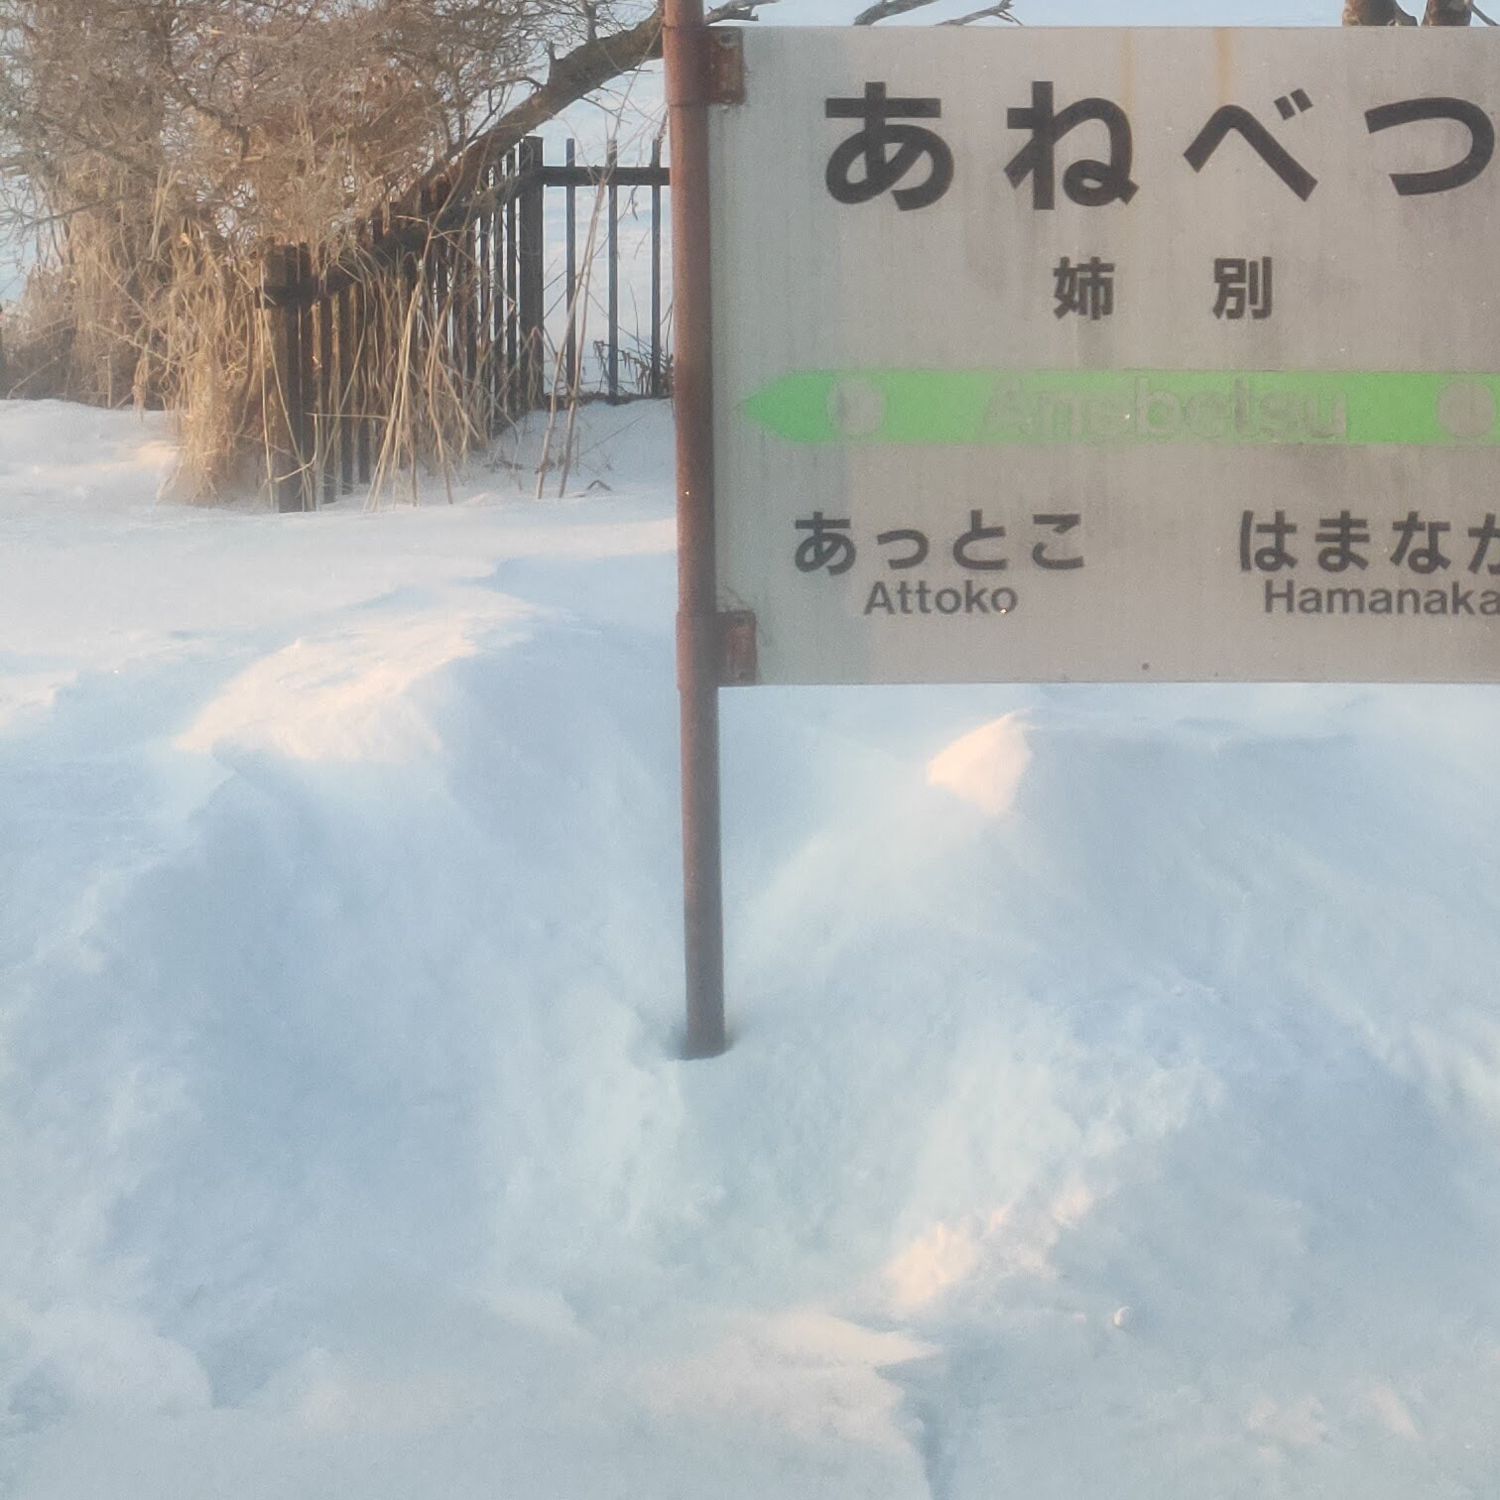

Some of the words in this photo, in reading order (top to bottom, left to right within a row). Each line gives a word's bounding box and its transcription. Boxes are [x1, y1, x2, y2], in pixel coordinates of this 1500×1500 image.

[824, 80, 1496, 212] あねべつ
[1052, 255, 1274, 322] 姉別
[793, 510, 1085, 577] あっとこ
[863, 580, 1019, 616] Attoko
